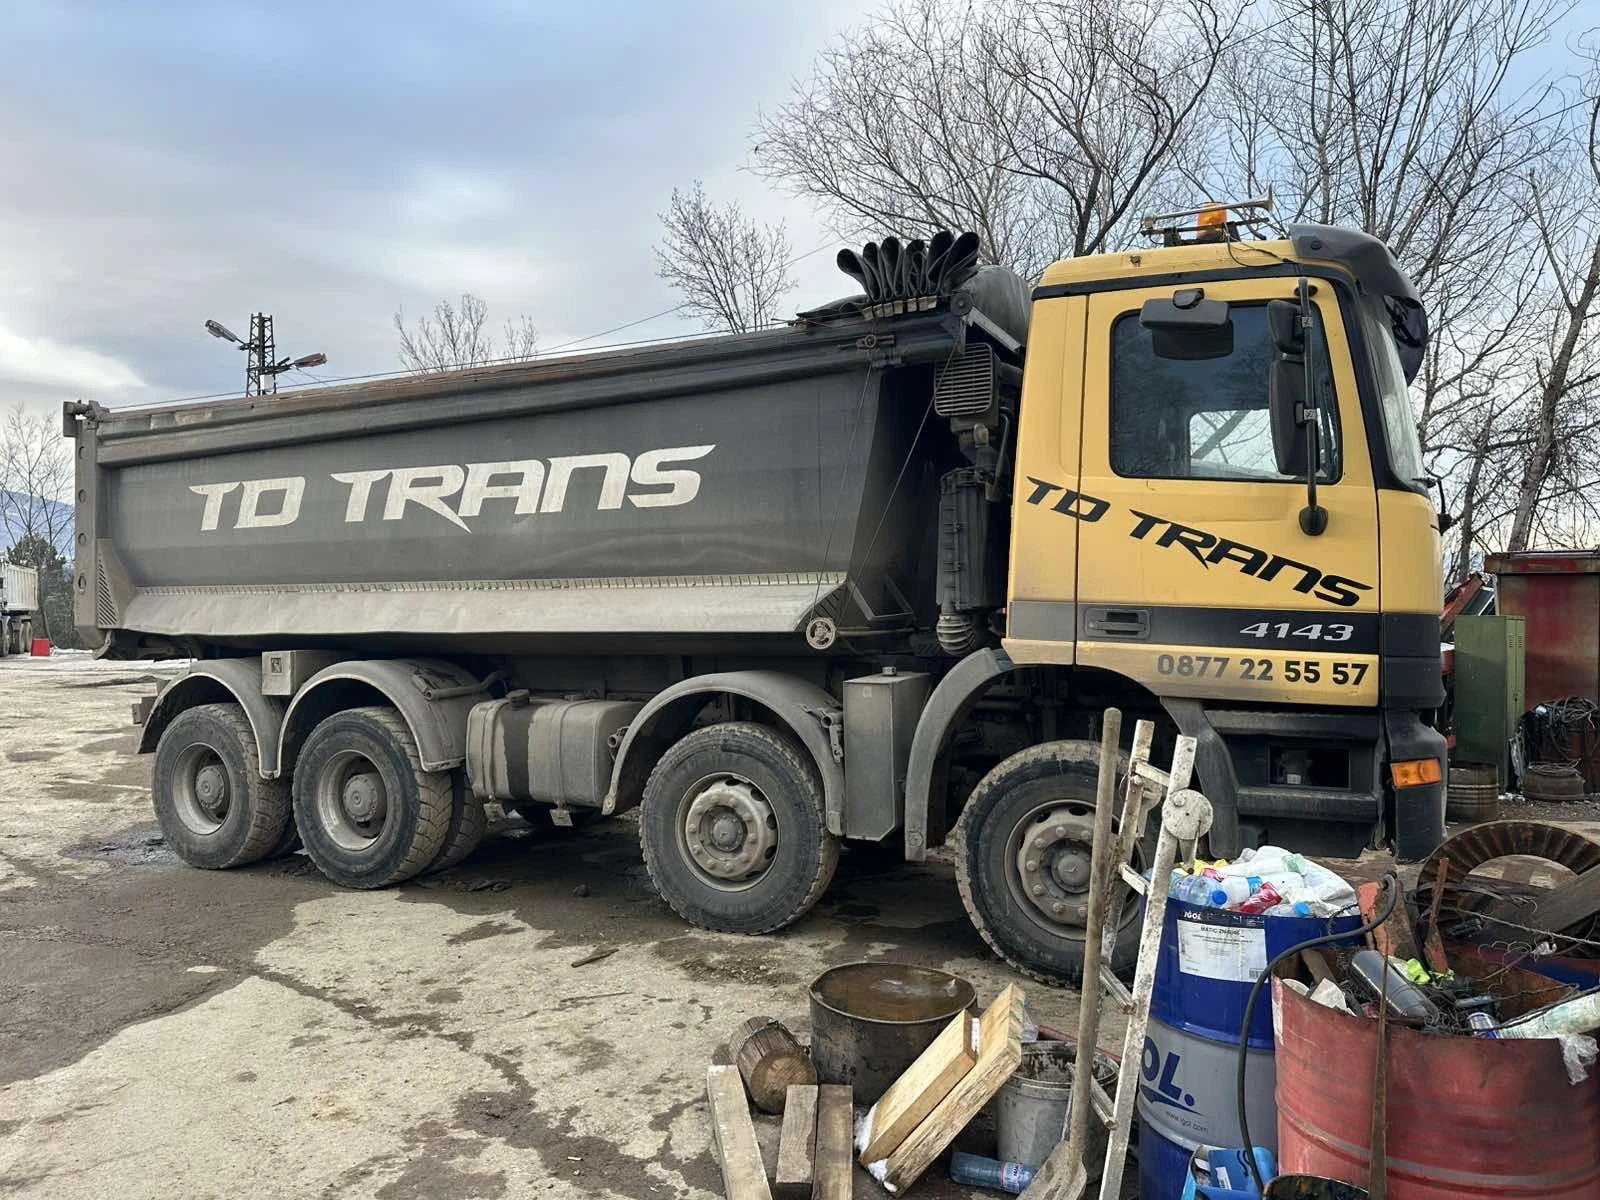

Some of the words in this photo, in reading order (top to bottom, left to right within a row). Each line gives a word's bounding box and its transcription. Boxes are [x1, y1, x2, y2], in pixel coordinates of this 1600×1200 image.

[189, 476, 306, 532] TD
[330, 444, 716, 534] TRANS
[1026, 476, 1112, 523] TD
[1128, 508, 1374, 607] TRANS
[1239, 622, 1355, 642] 4143
[1156, 654, 1231, 679] 0877
[1239, 658, 1274, 682] 22
[1284, 660, 1321, 684] 55
[1332, 663, 1370, 686] 57
